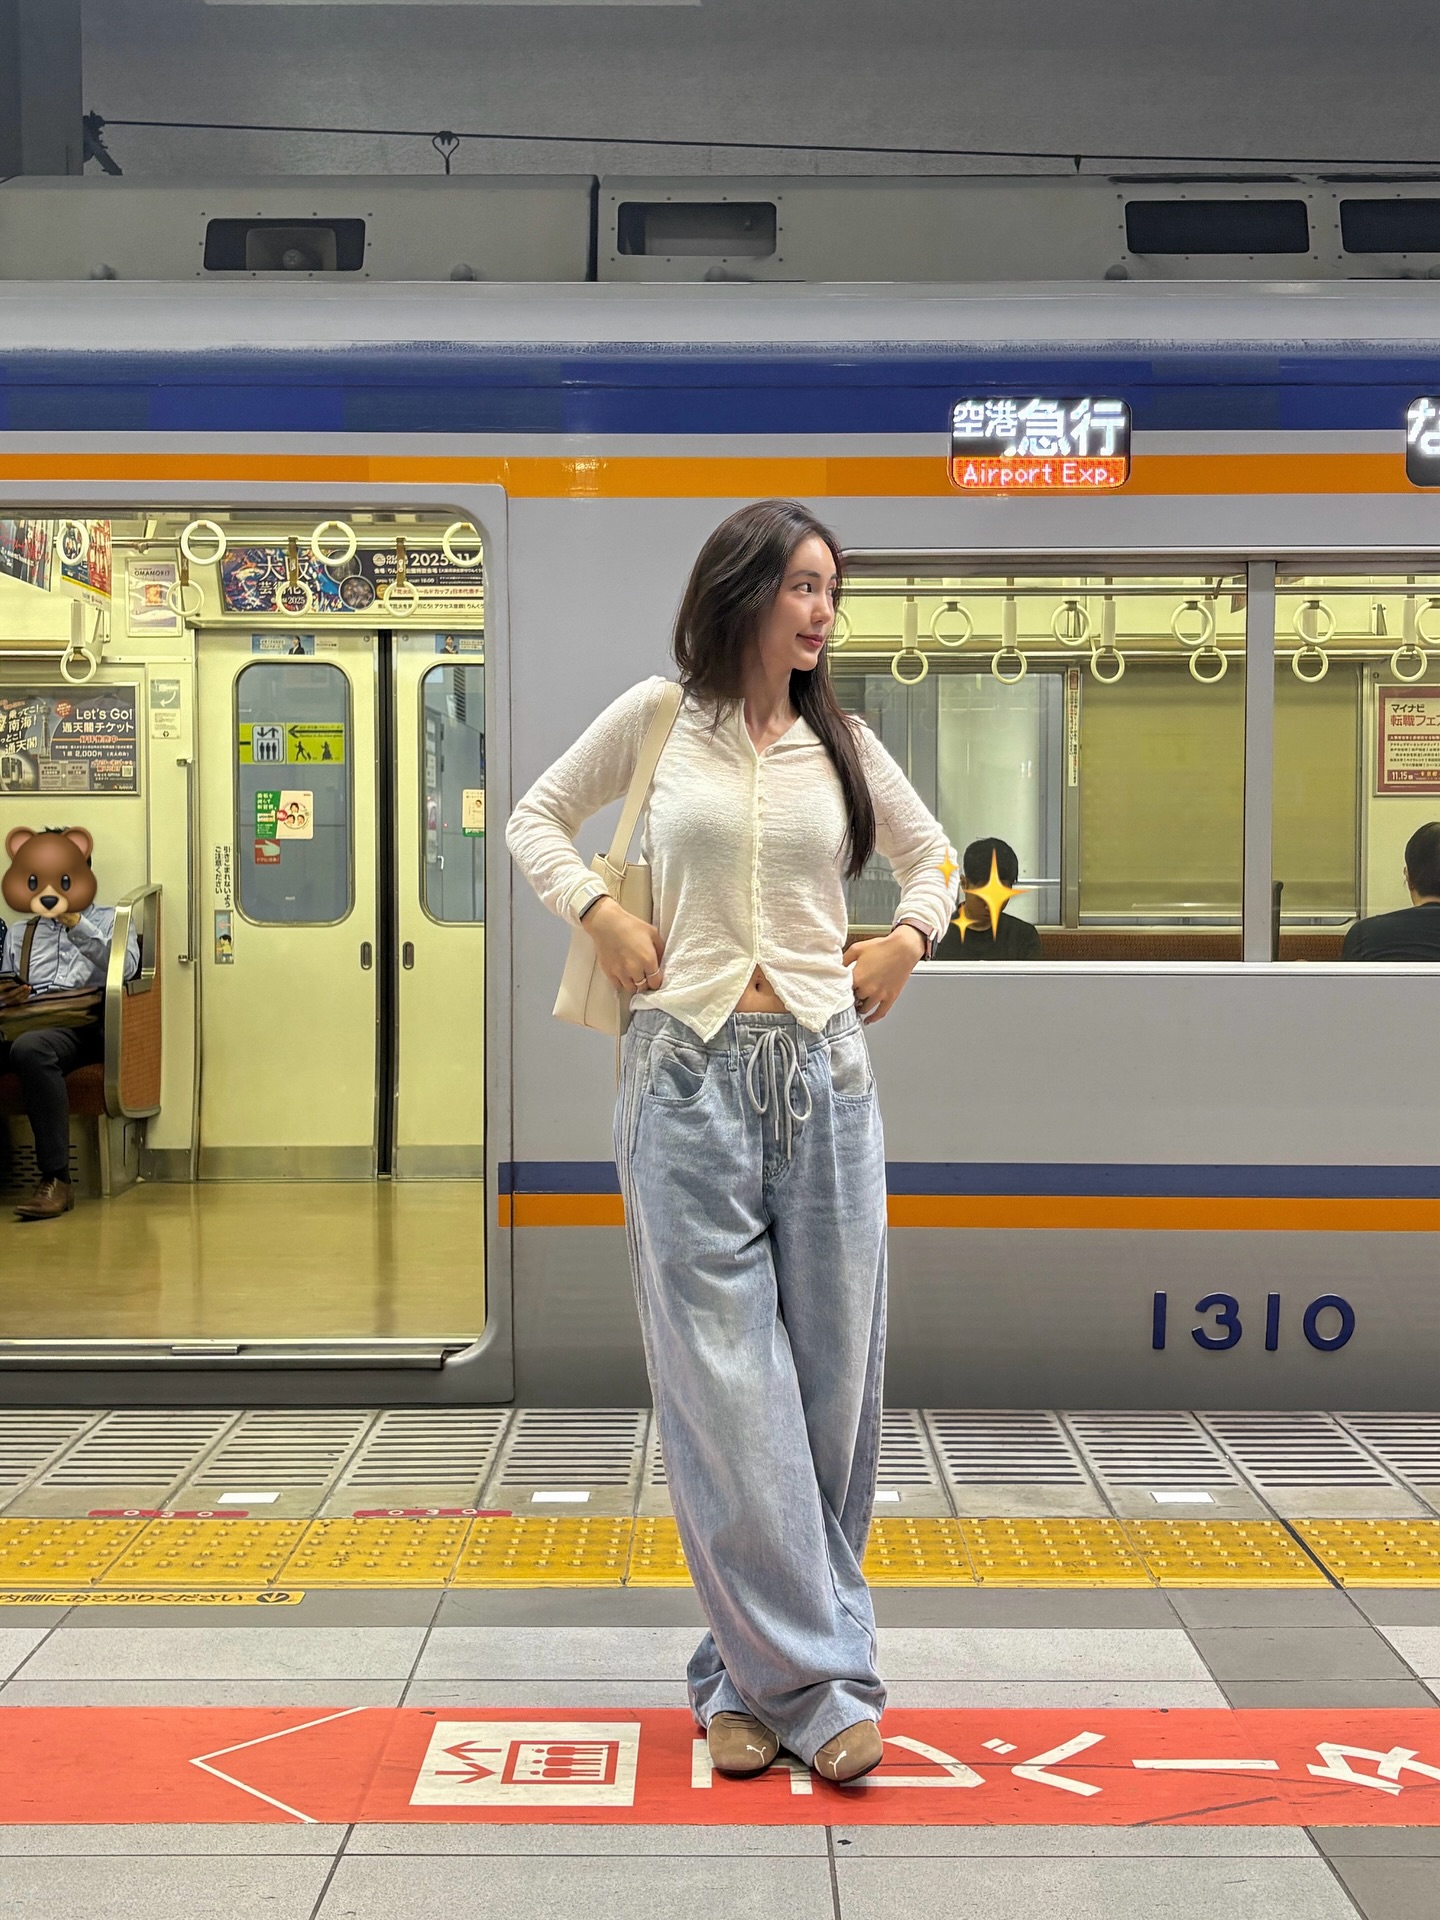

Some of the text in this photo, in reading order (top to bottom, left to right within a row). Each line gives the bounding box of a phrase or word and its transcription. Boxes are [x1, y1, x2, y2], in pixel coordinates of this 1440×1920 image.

[952, 398, 1126, 457] 空港急行
[963, 463, 1116, 486] Airport Exp.
[410, 553, 449, 567] 2025
[76, 708, 107, 720] Let's
[110, 708, 133, 720] Go!
[1391, 704, 1425, 713] マイナビ
[62, 721, 135, 733] 通天閣チケット
[1152, 1290, 1355, 1351] 1310
